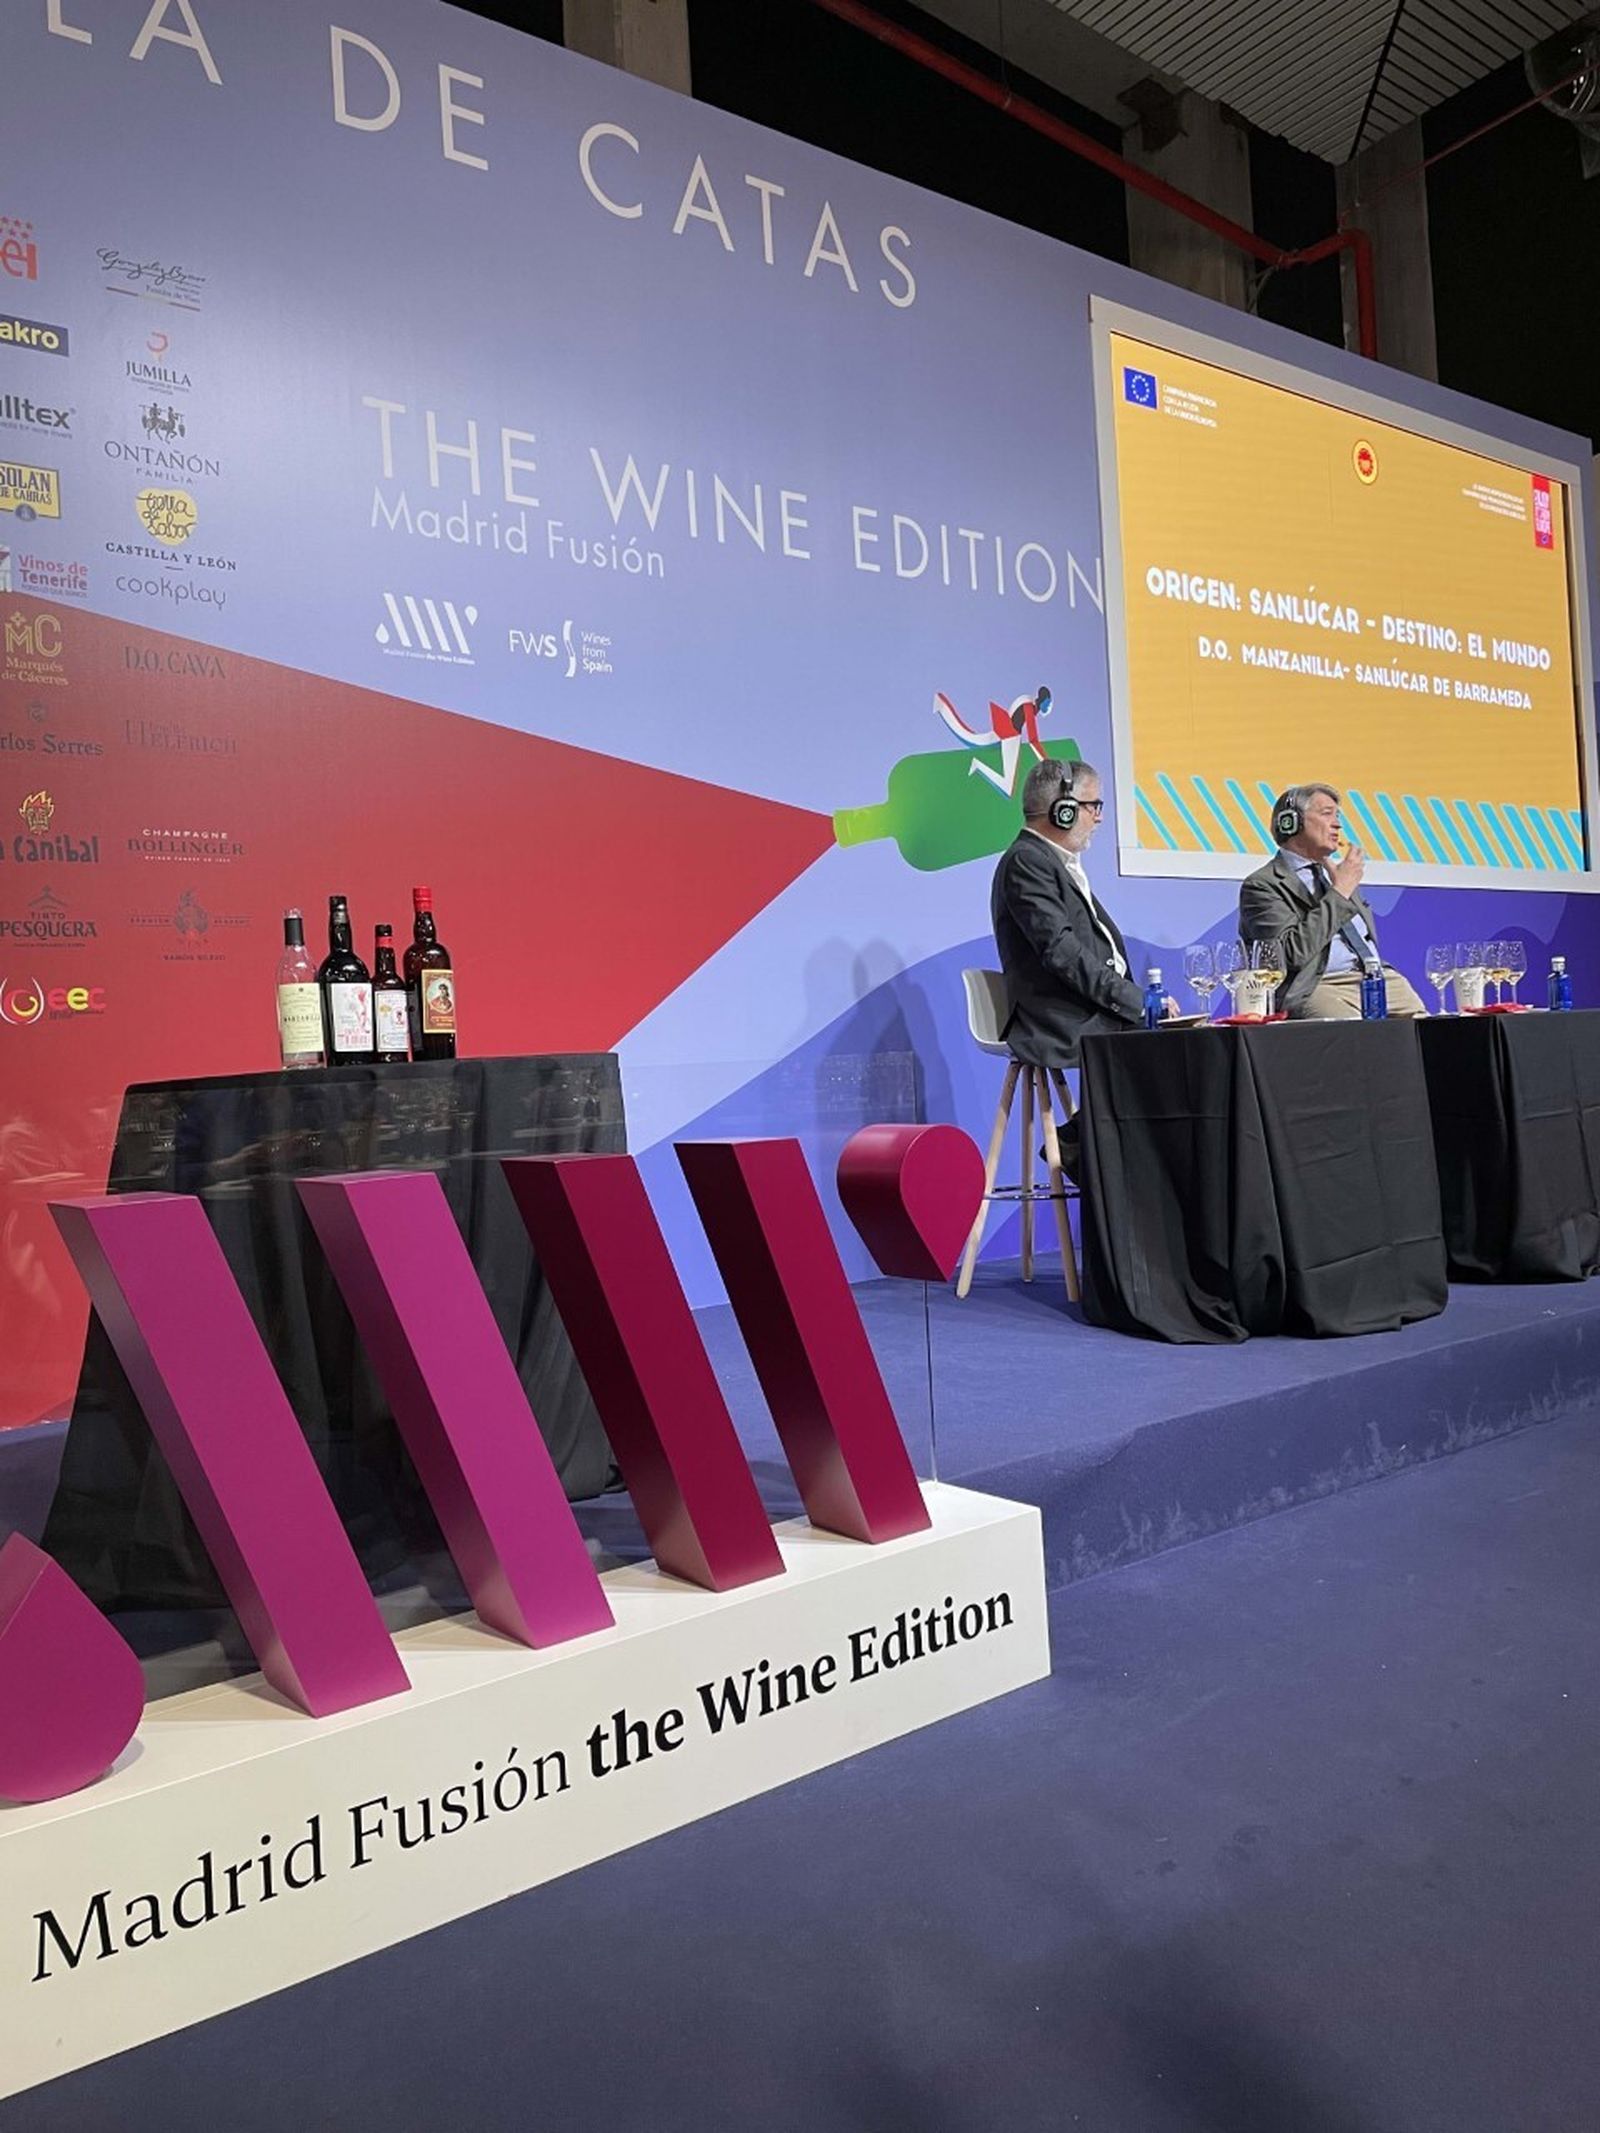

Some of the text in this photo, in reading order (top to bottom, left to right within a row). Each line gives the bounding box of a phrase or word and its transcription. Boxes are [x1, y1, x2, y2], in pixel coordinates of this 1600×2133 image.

[330, 24, 490, 171] DE
[579, 122, 917, 308] CATAS
[126, 360, 192, 388] JUMILLA
[104, 440, 220, 477] ONTAÑÓN
[136, 467, 193, 484] FAMILIA
[362, 395, 1104, 616] THE WINE EDITION
[371, 485, 664, 578] Madrid Fusión
[18, 554, 88, 576] Vinos de
[105, 542, 237, 570] CASTILLA Y LEÓN
[19, 568, 88, 590] Tenerife
[116, 575, 226, 611] cookplay
[1146, 566, 1242, 612] ORIGEN:
[1249, 585, 1361, 634] SANLÚCAR
[1382, 615, 1462, 654] DESTINO:
[1467, 632, 1487, 659] EL
[1492, 637, 1551, 671] MUNDO
[508, 629, 558, 657] FWS
[581, 631, 612, 646] Wines
[582, 644, 606, 658] from
[6, 655, 64, 674] Marqués
[124, 646, 227, 680] D.O. CAVA
[582, 657, 613, 674] Spain
[1198, 636, 1533, 710] D.O. MANZANILLA- SANLÚCAR DE BARRAMEDA
[1, 670, 69, 686] de Cáceres
[42, 733, 104, 756] Serres
[143, 828, 228, 840] CHAMPAGNE
[128, 839, 245, 855] BOLLINGER
[31, 912, 66, 920] TINTO
[0, 920, 97, 941] PESQUERA
[32, 1591, 1014, 1982] Madrid Fusión the Wine Edition
